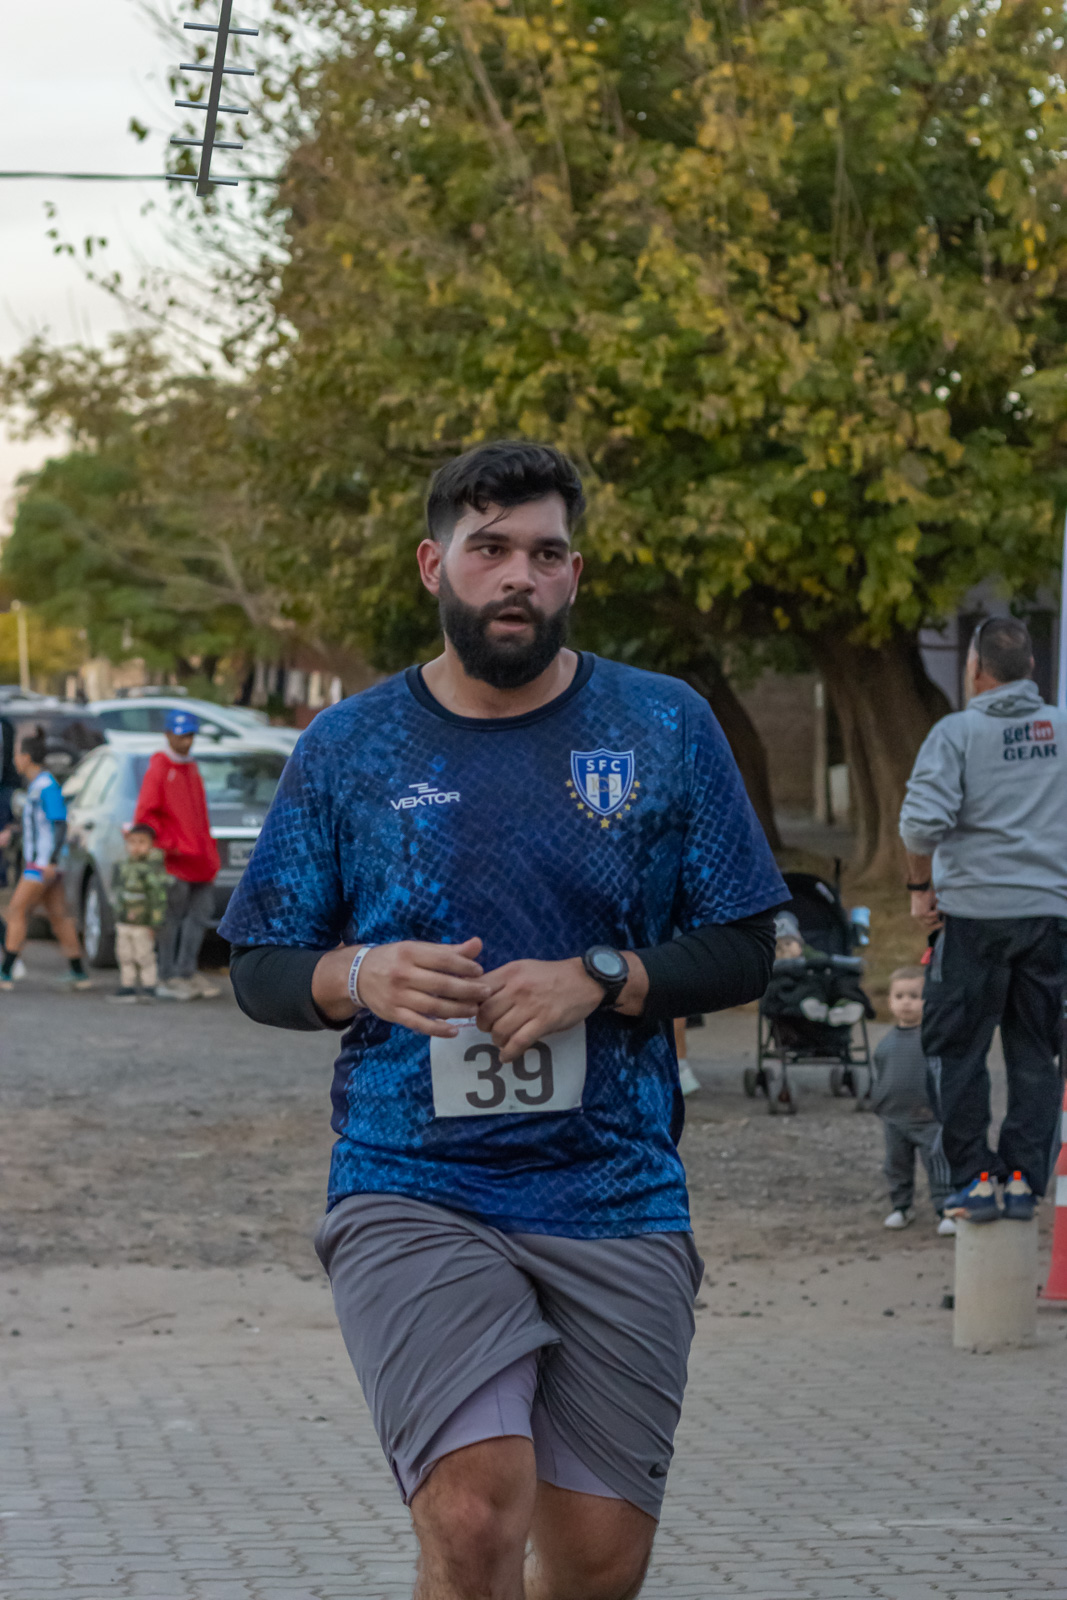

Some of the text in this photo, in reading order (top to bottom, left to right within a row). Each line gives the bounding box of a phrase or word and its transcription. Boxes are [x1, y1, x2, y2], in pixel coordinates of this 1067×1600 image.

[1003, 744, 1057, 761] GEAR
[586, 759, 621, 772] SFC
[390, 791, 461, 811] VEKTOR
[463, 1041, 554, 1109] 39
